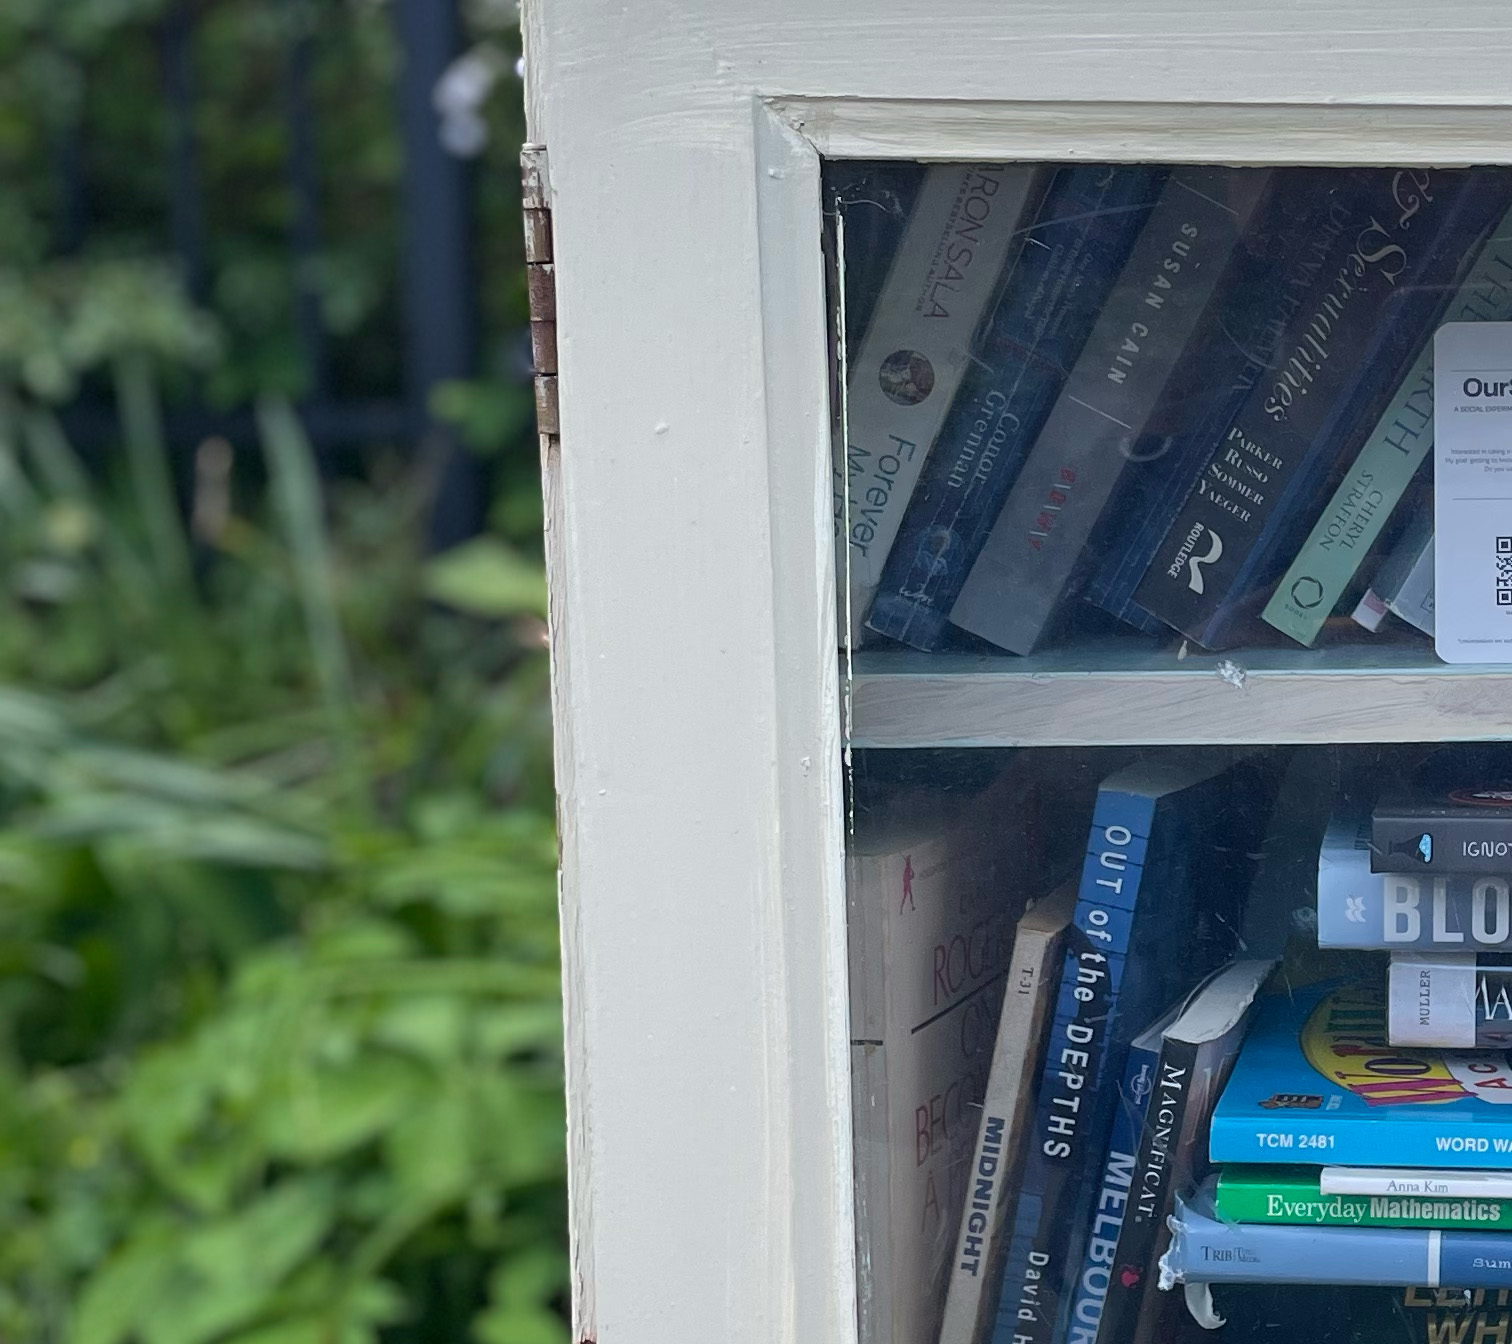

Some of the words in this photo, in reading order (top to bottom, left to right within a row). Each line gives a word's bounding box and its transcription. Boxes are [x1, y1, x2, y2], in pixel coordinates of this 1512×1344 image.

[922, 248, 974, 318] SALA
[1145, 223, 1198, 309] SUSAN
[1264, 216, 1407, 422] Sexualities
[1107, 322, 1149, 385] CAIN
[947, 389, 1006, 489] Grennan
[979, 412, 1020, 485] Conor
[1224, 447, 1269, 484] RUSSO
[1226, 426, 1284, 471] PARKER
[851, 433, 917, 557] Forever
[1198, 478, 1253, 524] YAEGER
[1206, 462, 1265, 507] SOMMER
[1318, 469, 1374, 552] STRAFFON
[1166, 520, 1206, 580] ROUTLEDGE
[1339, 489, 1384, 551] CHERYL
[1095, 823, 1133, 895] OUT
[1085, 908, 1113, 944] of
[1018, 966, 1035, 996] T-31
[1072, 950, 1107, 1003] the
[1418, 969, 1432, 1027] MULLER
[1043, 1021, 1095, 1160] DEPTHS
[1256, 1133, 1294, 1148] TCM
[1298, 1134, 1336, 1149] 2481
[1435, 1137, 1490, 1152] WORD
[959, 1115, 1006, 1278] MIDNIGHT
[1266, 1194, 1369, 1224] Everyday
[1369, 1197, 1501, 1221] Mathematics
[1386, 1180, 1420, 1193] Anna
[1423, 1180, 1449, 1194] Kim
[1015, 1250, 1050, 1323] David
